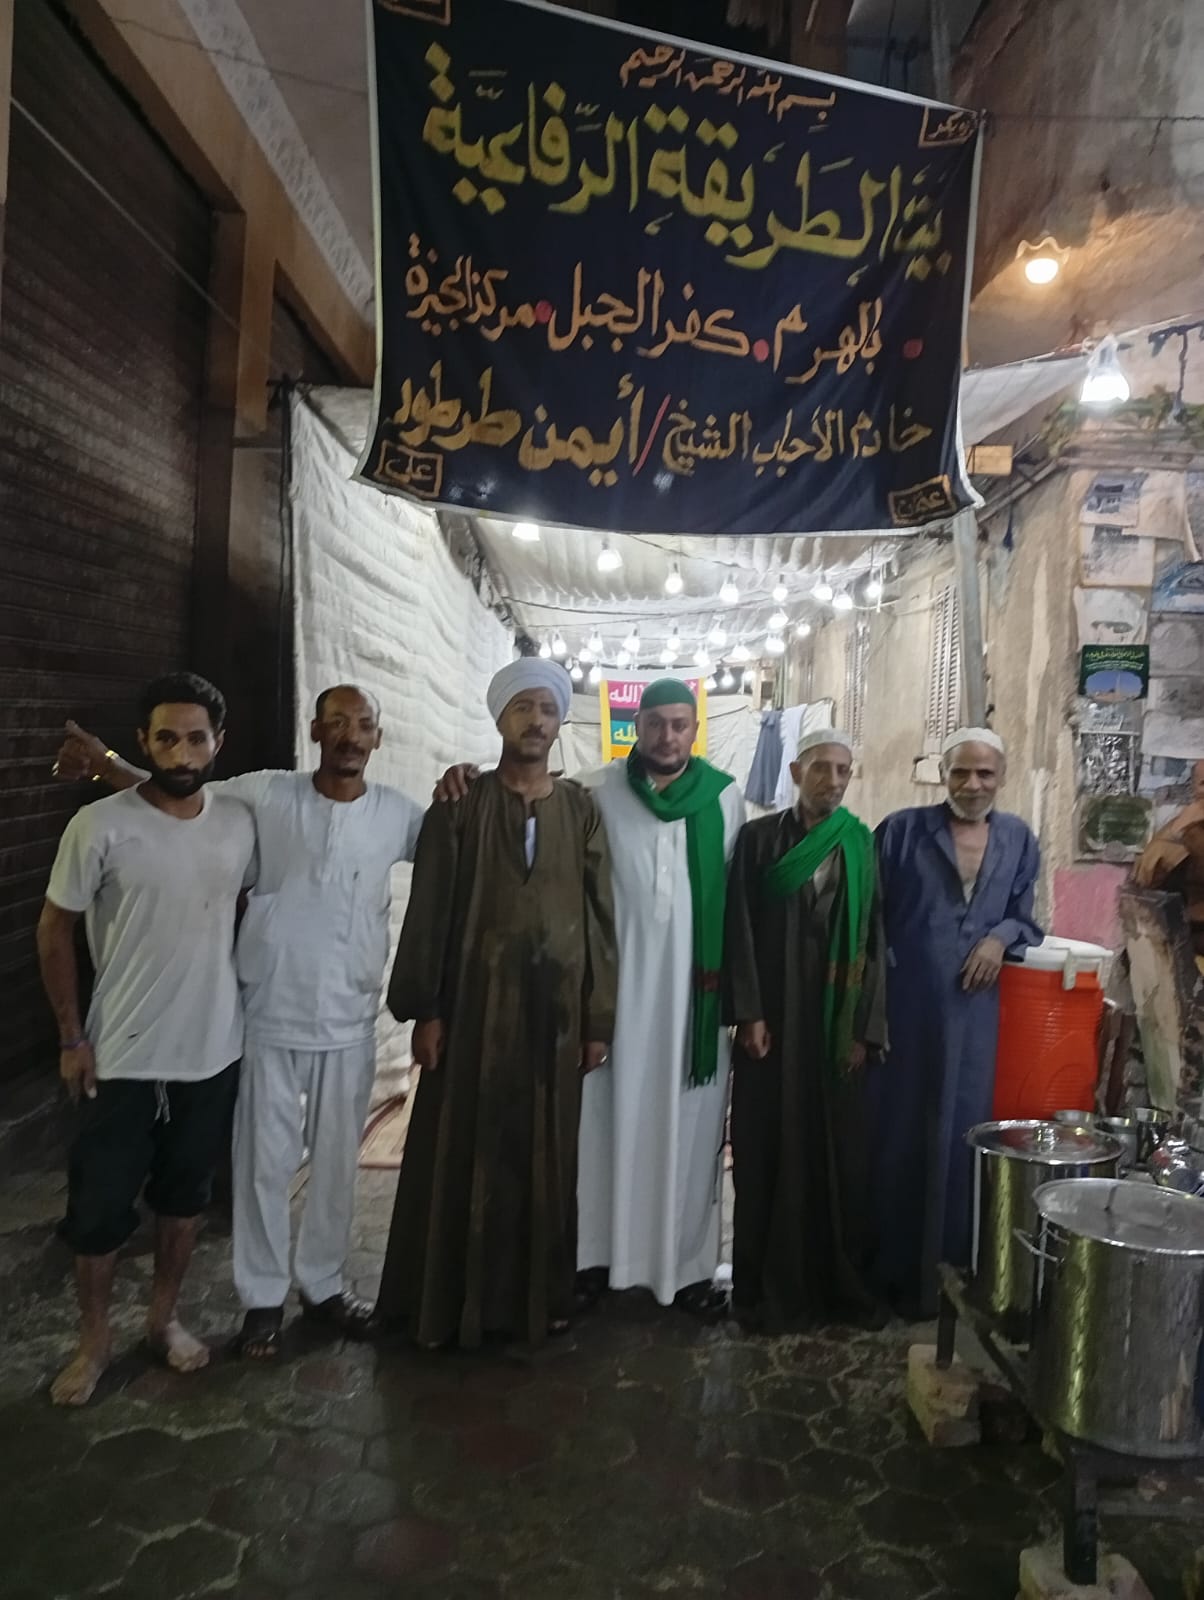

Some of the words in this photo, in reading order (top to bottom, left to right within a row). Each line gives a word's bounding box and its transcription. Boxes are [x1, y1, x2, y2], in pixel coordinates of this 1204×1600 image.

[618, 45, 687, 89] الرحيم
[683, 57, 747, 108] الرحمن
[746, 68, 783, 115] الله
[422, 41, 639, 214] الرفاعية
[777, 91, 836, 133] بسم
[647, 103, 902, 270] الطريقة
[405, 233, 473, 337] الجيزة
[465, 269, 537, 342] مركز
[548, 262, 665, 352] الجبل
[635, 282, 750, 359] كفر
[773, 297, 883, 384] بالهرم
[518, 373, 646, 488] أيمن
[662, 399, 751, 477] الشيخ
[850, 402, 933, 460] خادم
